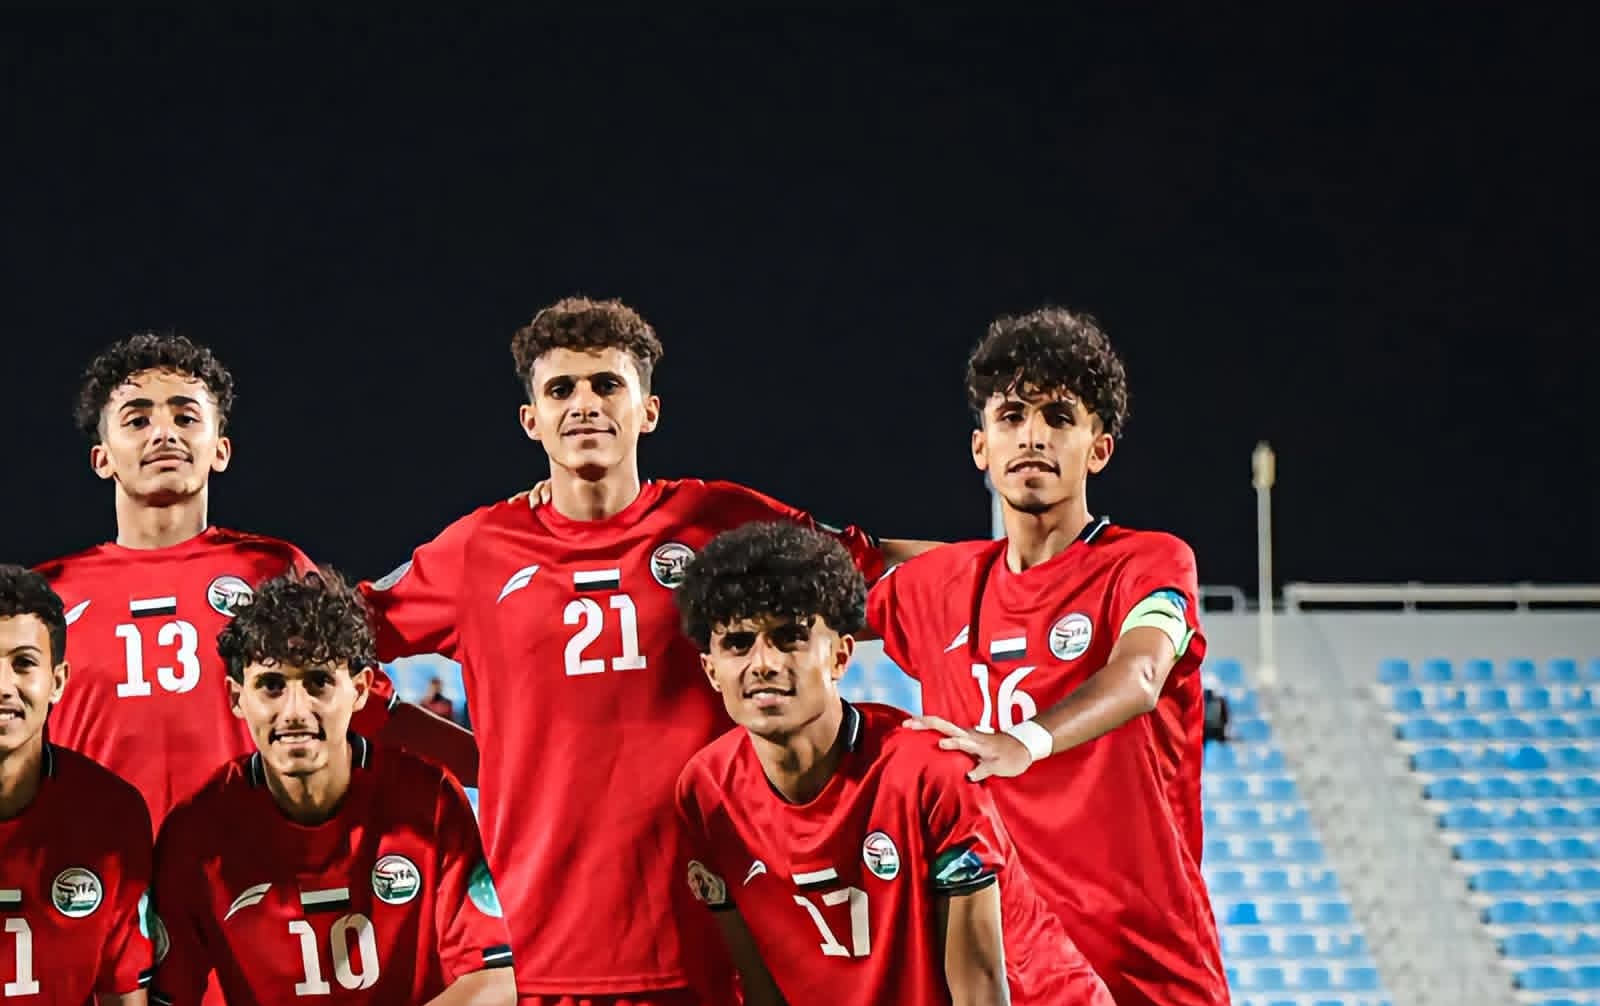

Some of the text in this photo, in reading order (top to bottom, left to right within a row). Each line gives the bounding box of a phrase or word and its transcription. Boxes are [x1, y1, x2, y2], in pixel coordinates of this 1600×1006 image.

[115, 620, 201, 698] 13
[563, 594, 647, 676] 21
[971, 663, 1037, 734] 16
[289, 914, 379, 996] 10
[793, 887, 870, 957] 17
